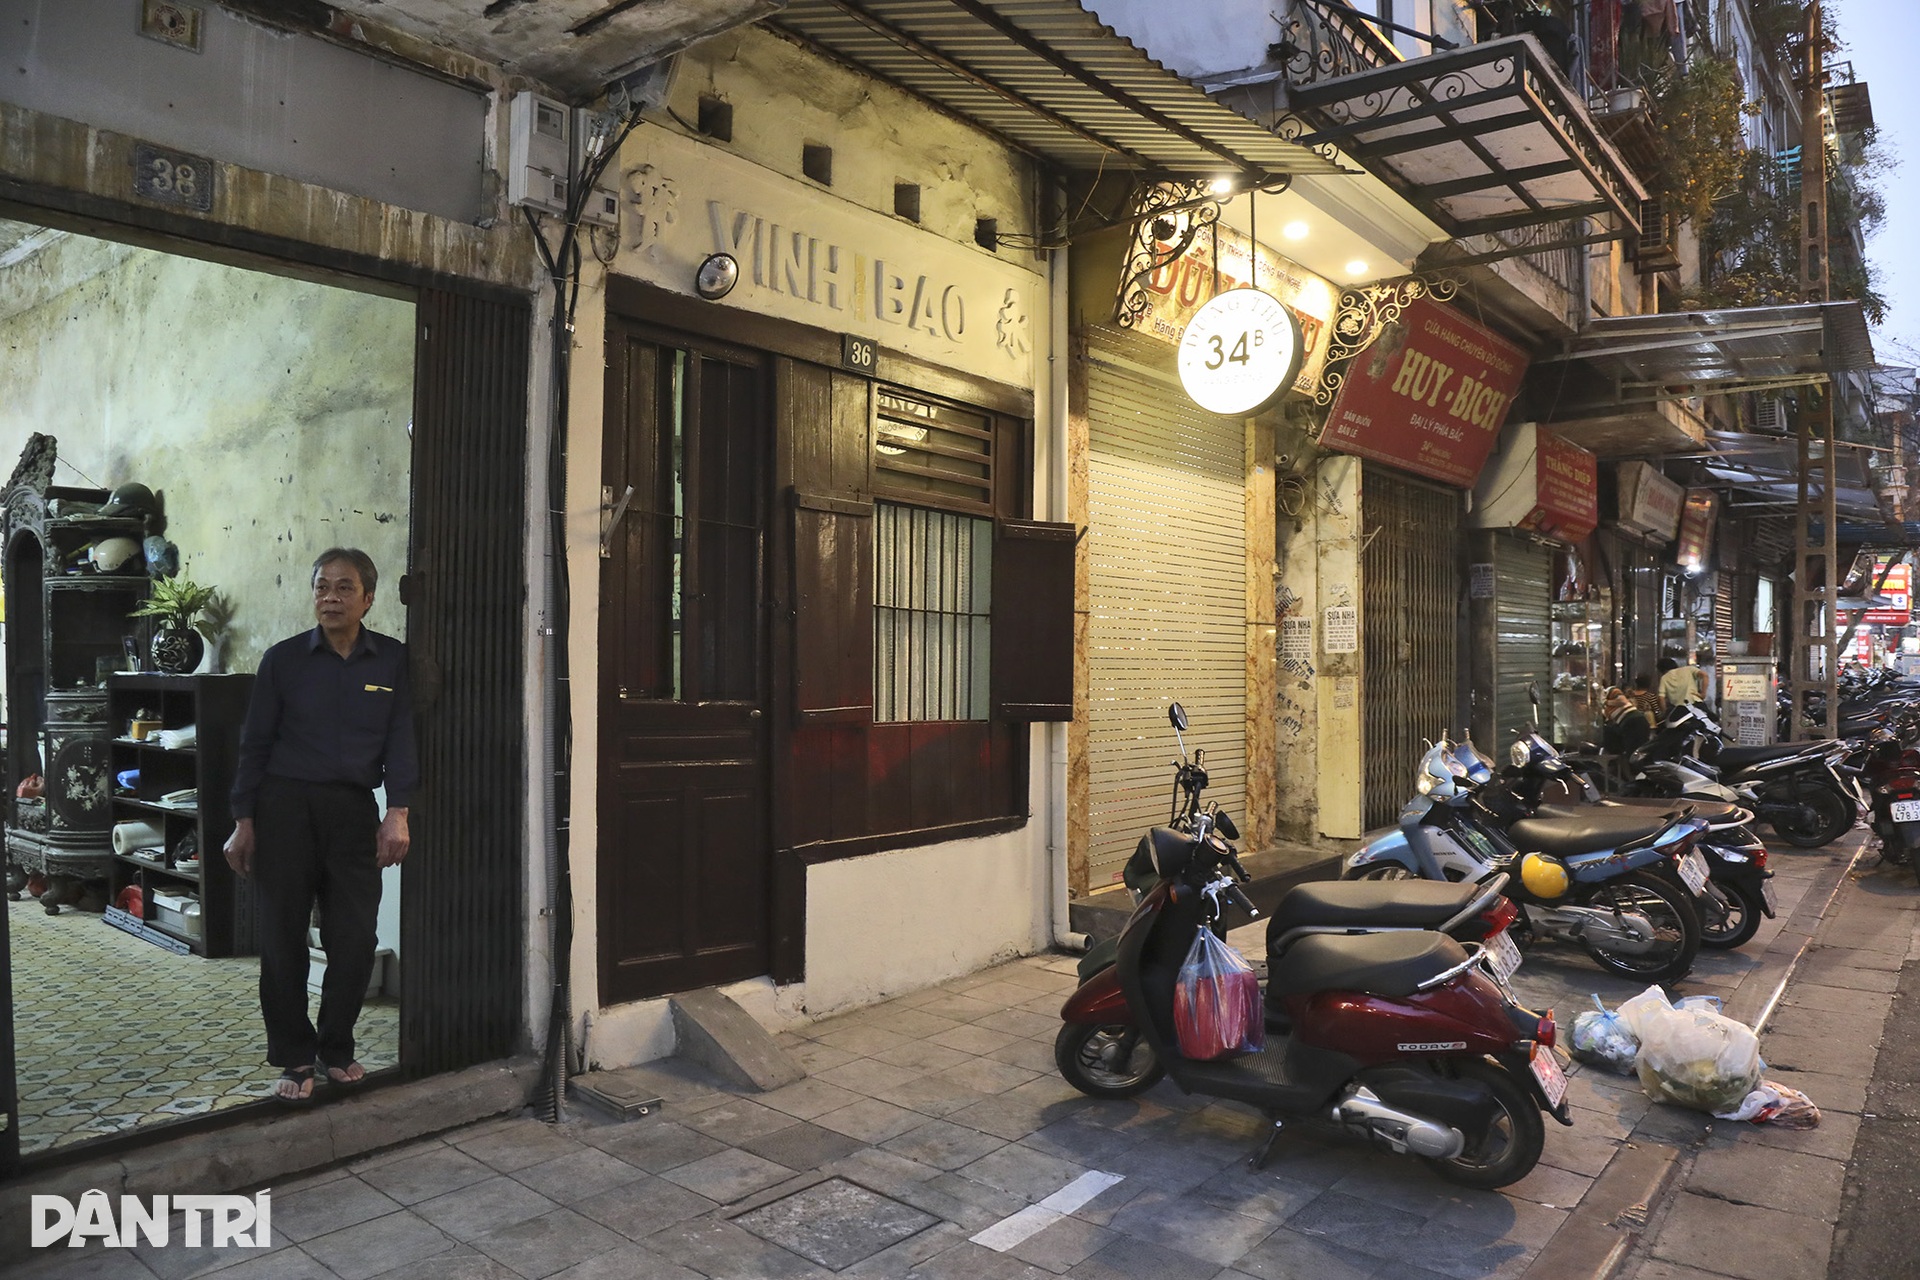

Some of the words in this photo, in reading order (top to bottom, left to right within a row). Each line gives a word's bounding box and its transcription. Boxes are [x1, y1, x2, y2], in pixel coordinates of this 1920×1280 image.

[152, 158, 197, 197] 38
[851, 341, 872, 367] 36
[1391, 347, 1454, 407] HUY
[1449, 369, 1508, 431] BÍCH
